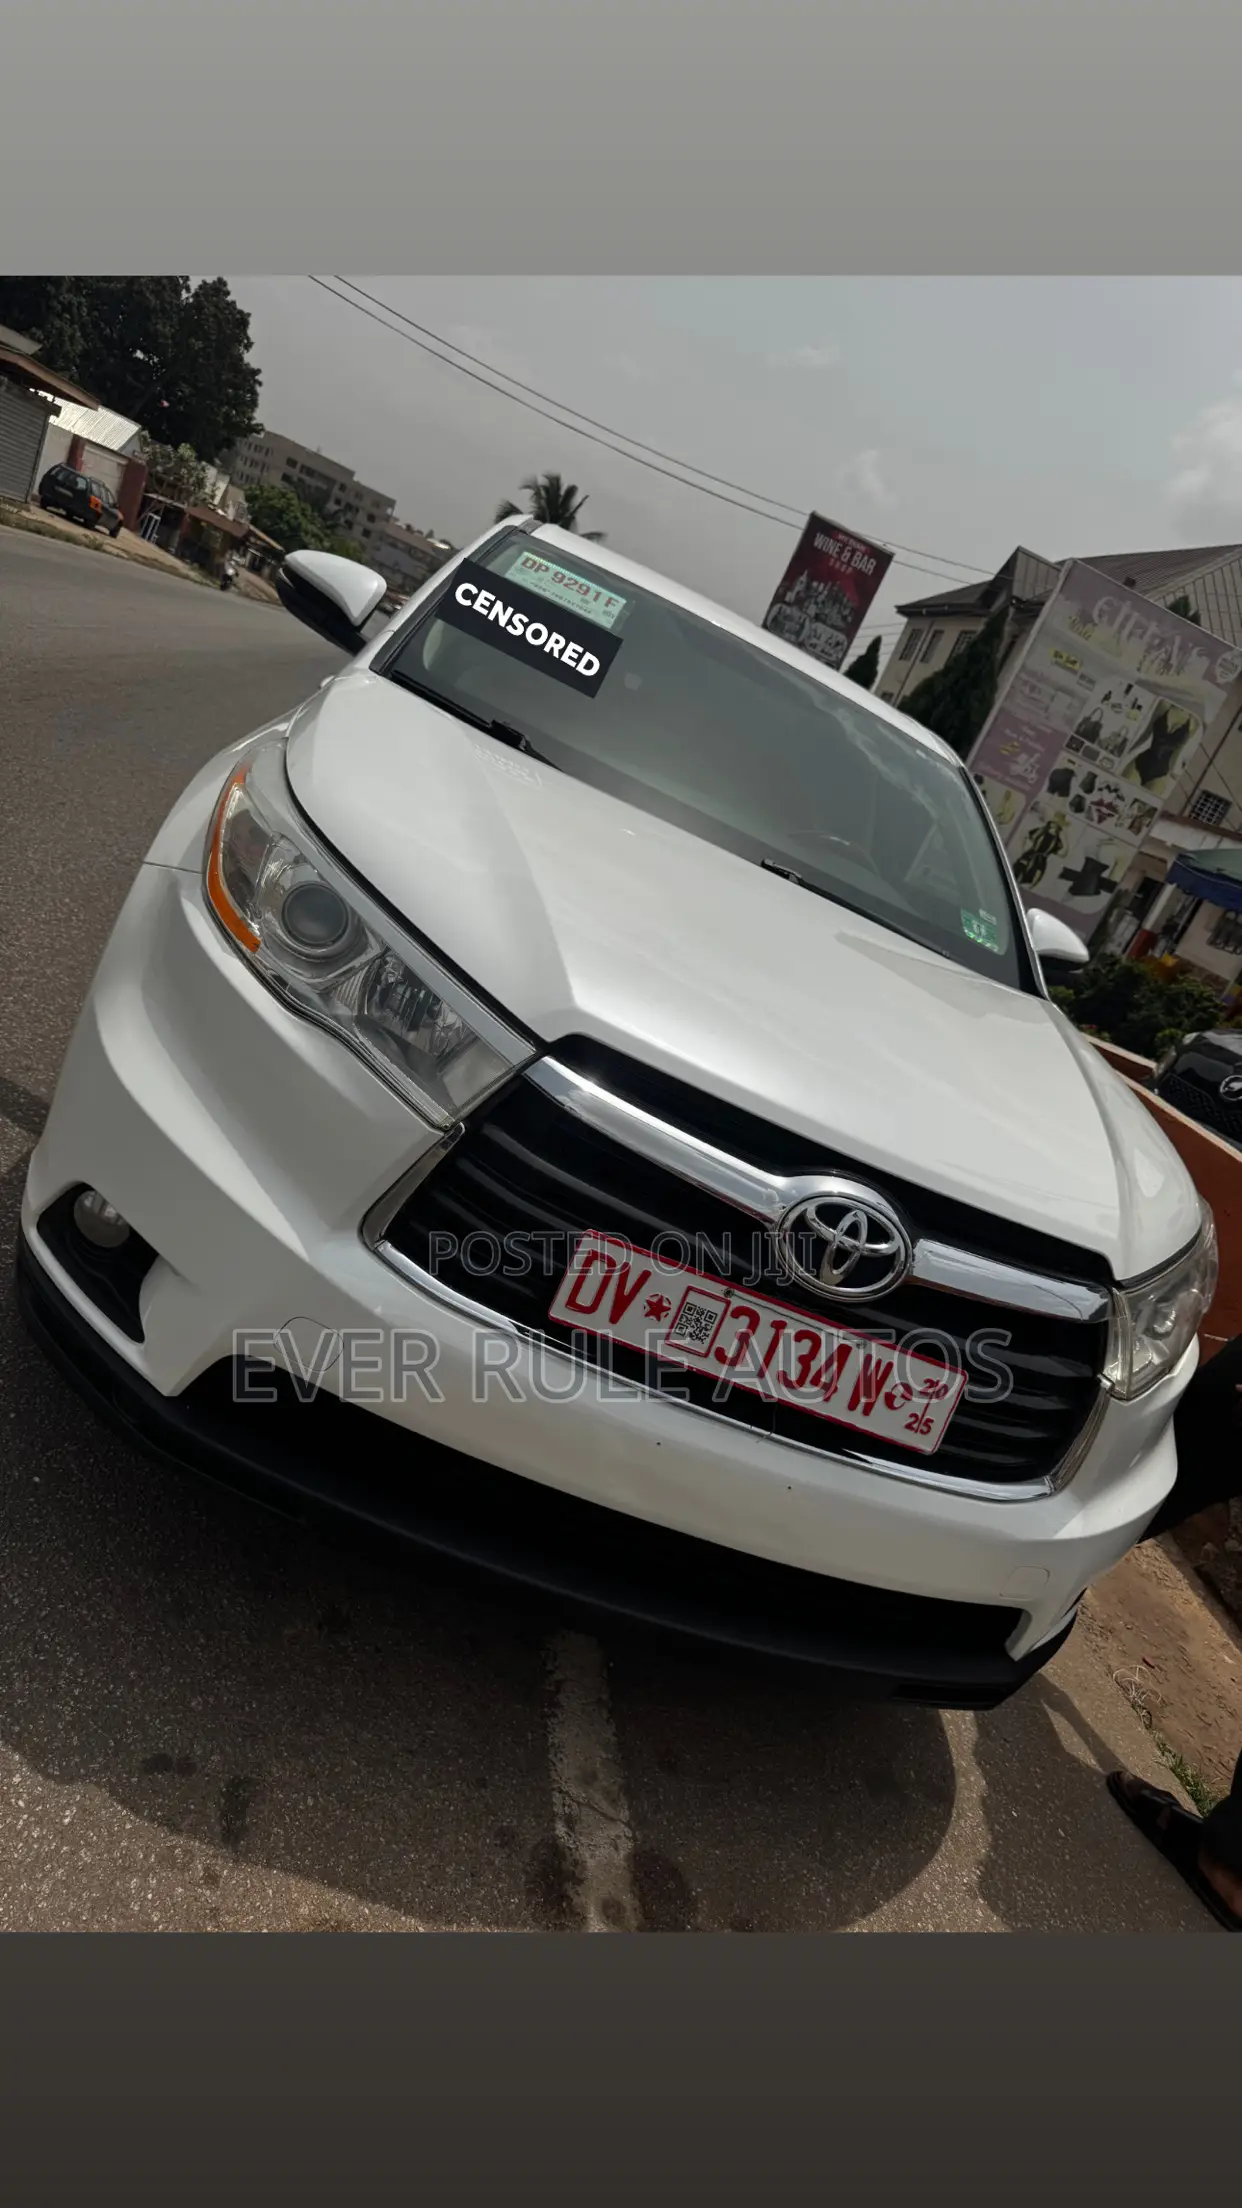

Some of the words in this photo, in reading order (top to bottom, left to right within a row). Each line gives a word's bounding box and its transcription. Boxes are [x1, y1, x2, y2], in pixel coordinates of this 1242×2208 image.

[521, 556, 550, 574] DP
[814, 532, 843, 560] WINE
[841, 547, 852, 563] &
[851, 550, 877, 576] BAR
[565, 1249, 652, 1325] DV
